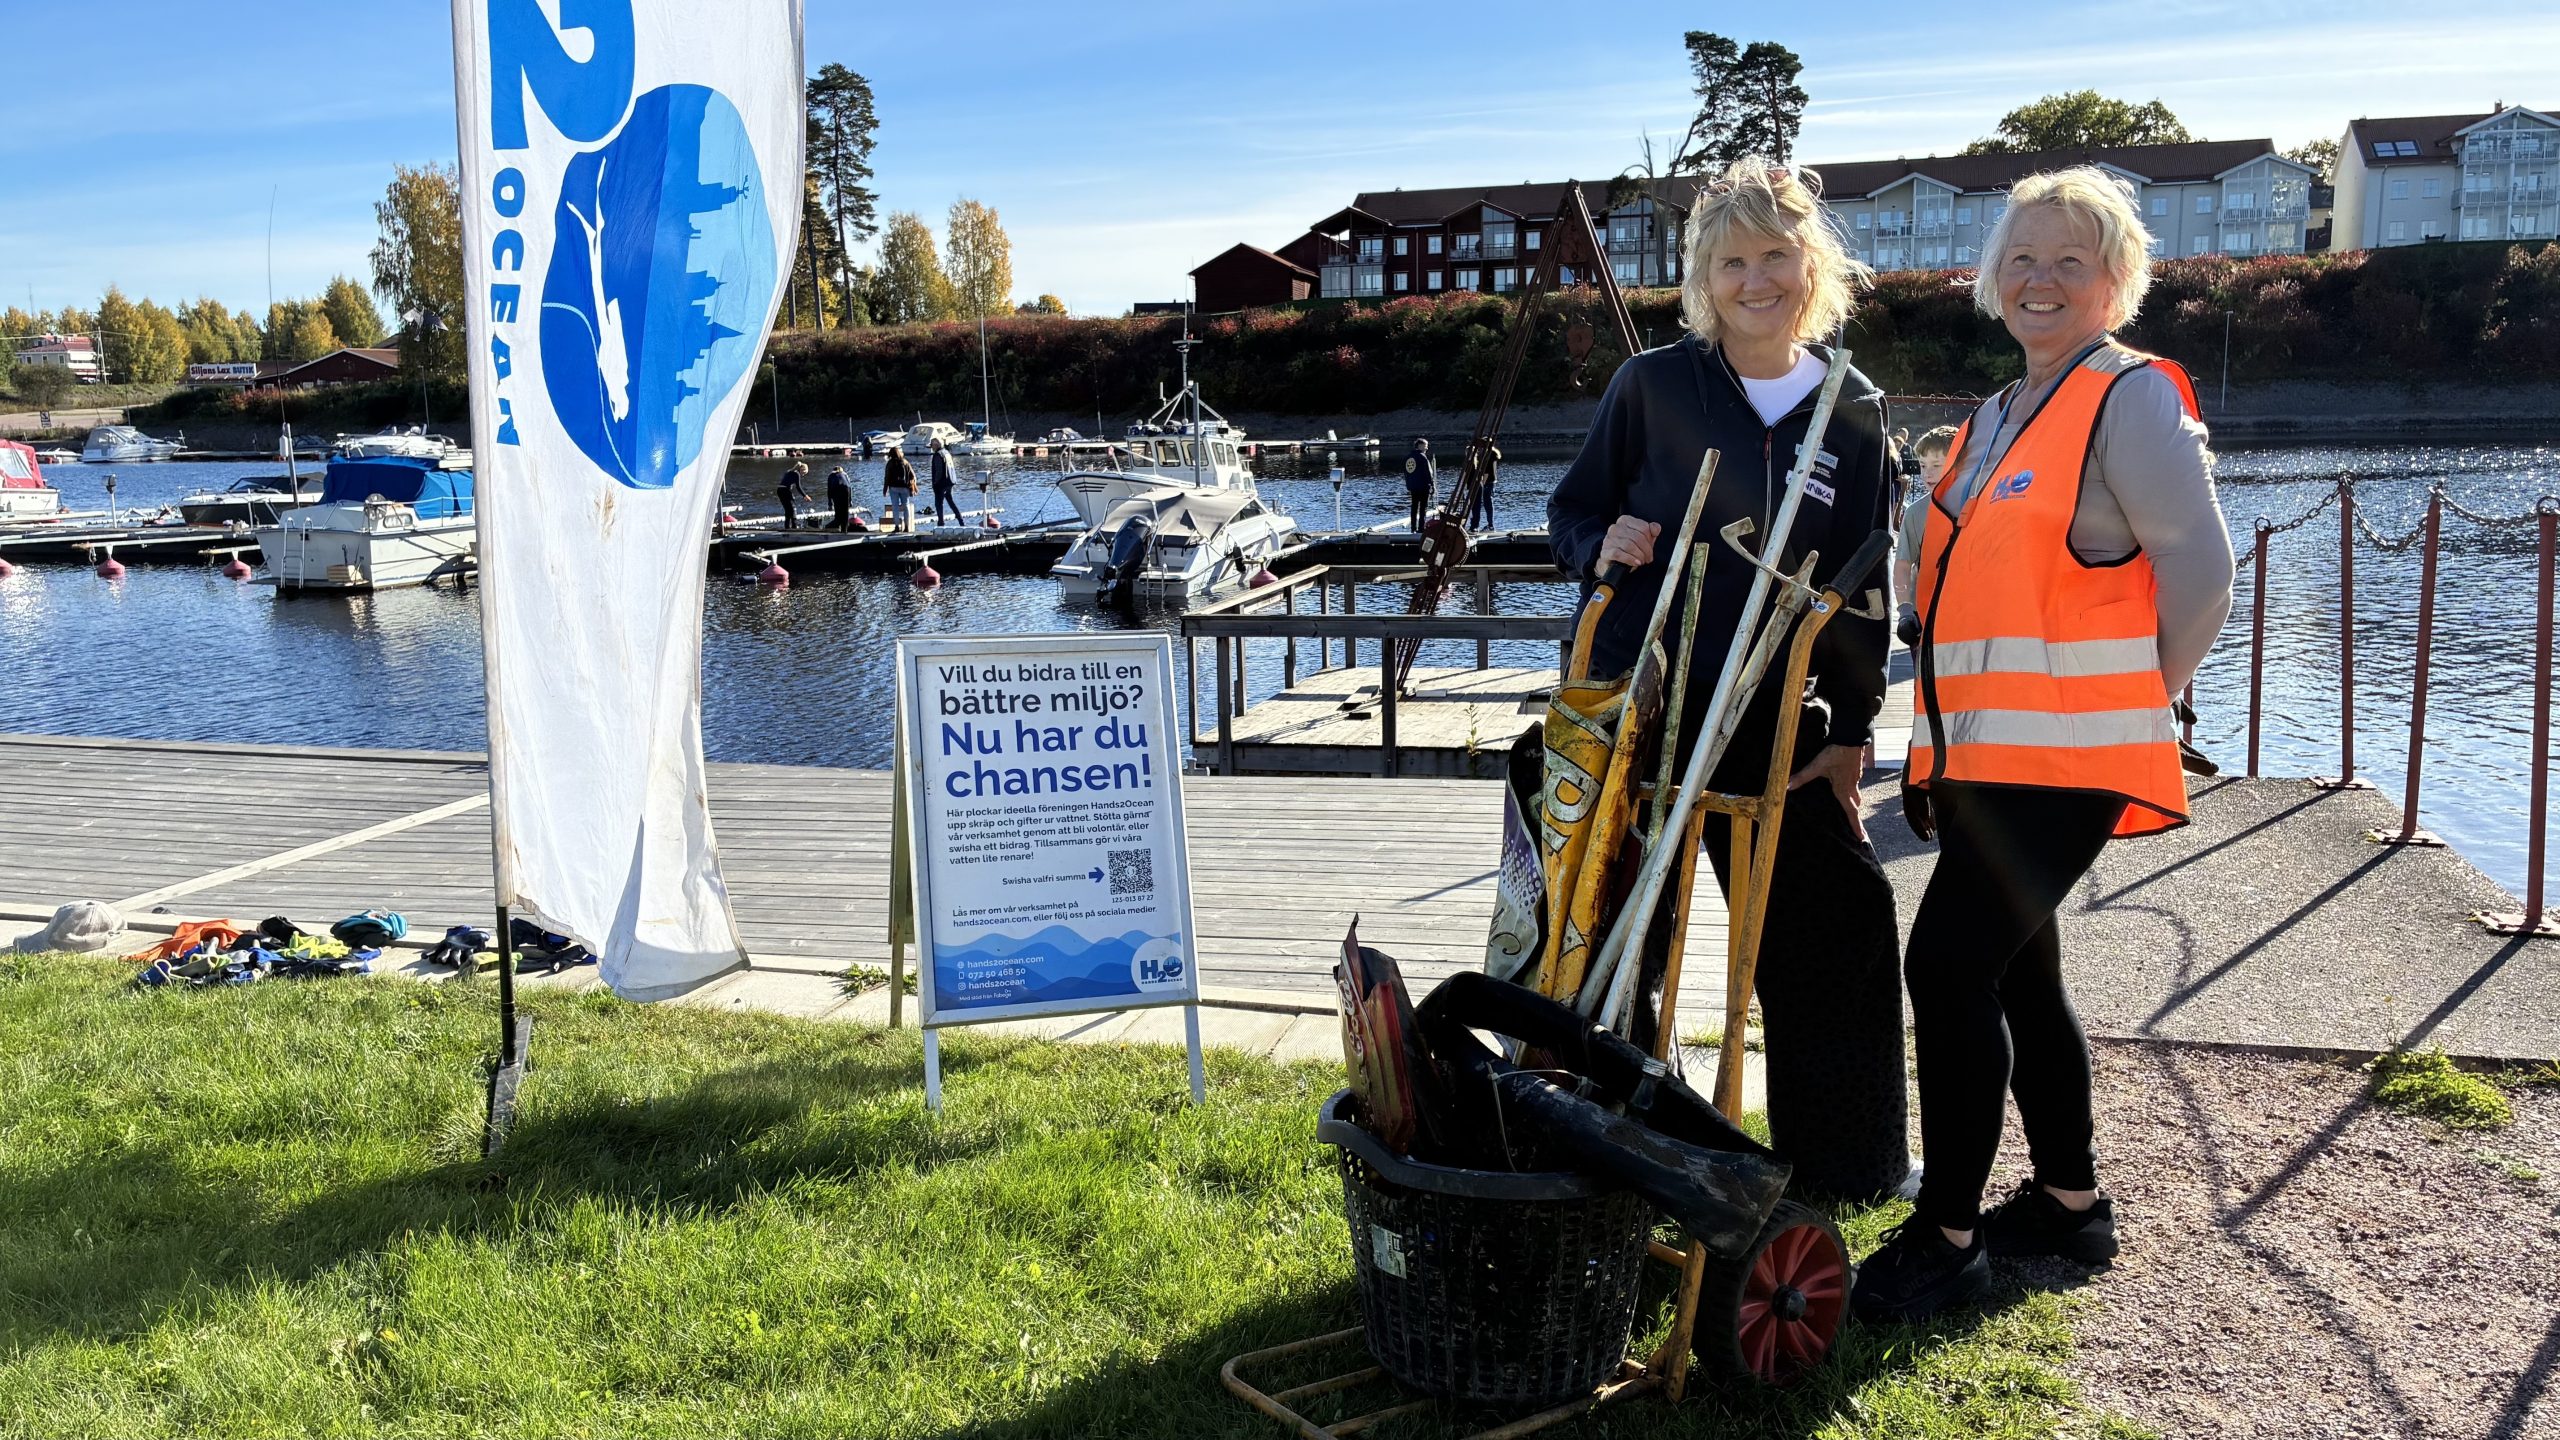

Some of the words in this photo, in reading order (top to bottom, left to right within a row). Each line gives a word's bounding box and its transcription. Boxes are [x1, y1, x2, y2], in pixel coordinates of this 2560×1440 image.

[491, 166, 526, 446] OCEAN
[191, 366, 216, 376] Siljans
[217, 366, 230, 374] Lax
[233, 366, 254, 374] BUTIK
[939, 665, 977, 683] Vill
[983, 665, 1011, 682] du
[1019, 664, 1076, 681] bidra
[1081, 662, 1111, 680] till
[1116, 666, 1142, 678] en
[940, 688, 1041, 715] bättre
[1052, 684, 1143, 716] miljö?
[942, 722, 1002, 755] Nu
[1015, 720, 1083, 752] har
[1095, 716, 1148, 750] du
[945, 754, 1152, 797] chansen!
[947, 808, 964, 818] Här
[966, 807, 1001, 818] plockar
[1004, 806, 1036, 815] ideella
[1039, 803, 1089, 814] föreningen
[1091, 800, 1154, 810] Hands2Ocean
[948, 821, 966, 830] upp
[969, 817, 994, 829] skräp
[998, 817, 1014, 827] och
[1017, 815, 1042, 827] gifter
[1056, 814, 1090, 823] vattnet.
[1094, 812, 1121, 821] Stötta
[1123, 811, 1150, 821] gärna
[948, 831, 963, 841] vår
[965, 830, 1020, 840] verksamhet
[1023, 828, 1055, 838] genom
[1058, 826, 1071, 835] att
[1073, 825, 1085, 834] bli
[1087, 823, 1125, 832] volontär,
[1128, 822, 1149, 830] eller
[949, 844, 981, 853] swisha
[984, 843, 997, 851] ett
[1000, 840, 1032, 851] bidrag.
[1034, 837, 1093, 848] Tillsammans
[1095, 835, 1111, 846] gör
[1113, 835, 1120, 843] vi
[1122, 834, 1142, 842] våra
[950, 856, 980, 864] vatten
[983, 854, 998, 863] lite
[1000, 852, 1034, 861] renare!
[1002, 876, 1031, 885] Swisha
[1033, 875, 1054, 883] valfri
[953, 907, 967, 917] Läs
[1004, 904, 1016, 913] vår
[1018, 902, 1066, 912] verksamhet
[1068, 901, 1079, 910] på
[953, 916, 1031, 927] hands2ocean.com,
[1034, 913, 1052, 922] eller
[1054, 912, 1068, 921] följ
[1085, 910, 1096, 919] på
[1098, 908, 1126, 917] sociala
[968, 956, 1044, 968] hands2ocean.com
[968, 971, 983, 980] 072
[998, 968, 1013, 977] 468
[969, 979, 1025, 989] hands2ocean
